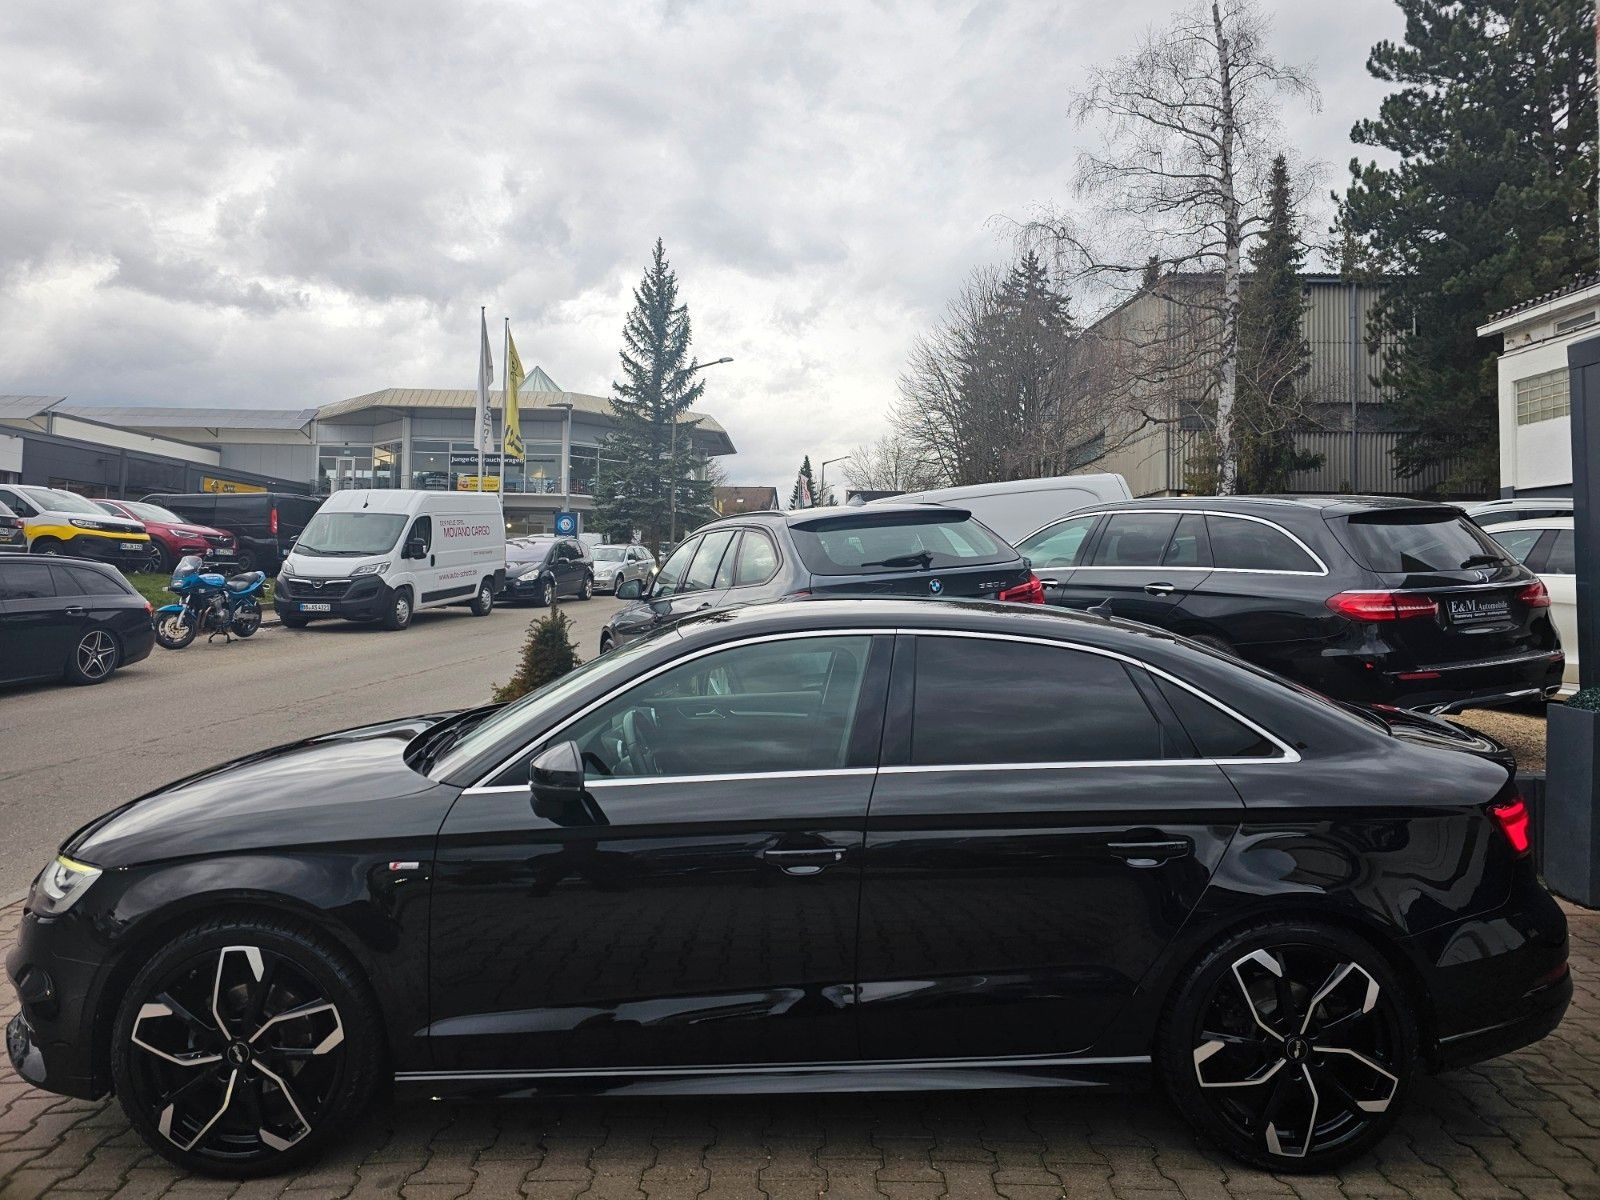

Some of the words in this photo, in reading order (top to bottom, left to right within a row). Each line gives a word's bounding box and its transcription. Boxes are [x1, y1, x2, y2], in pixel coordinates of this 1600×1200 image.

[469, 456, 525, 465] Gerauchwagen
[443, 526, 471, 538] MOVANO
[471, 525, 490, 536] CARGO
[1451, 600, 1476, 612] E&M
[1478, 601, 1508, 610] Automobile
